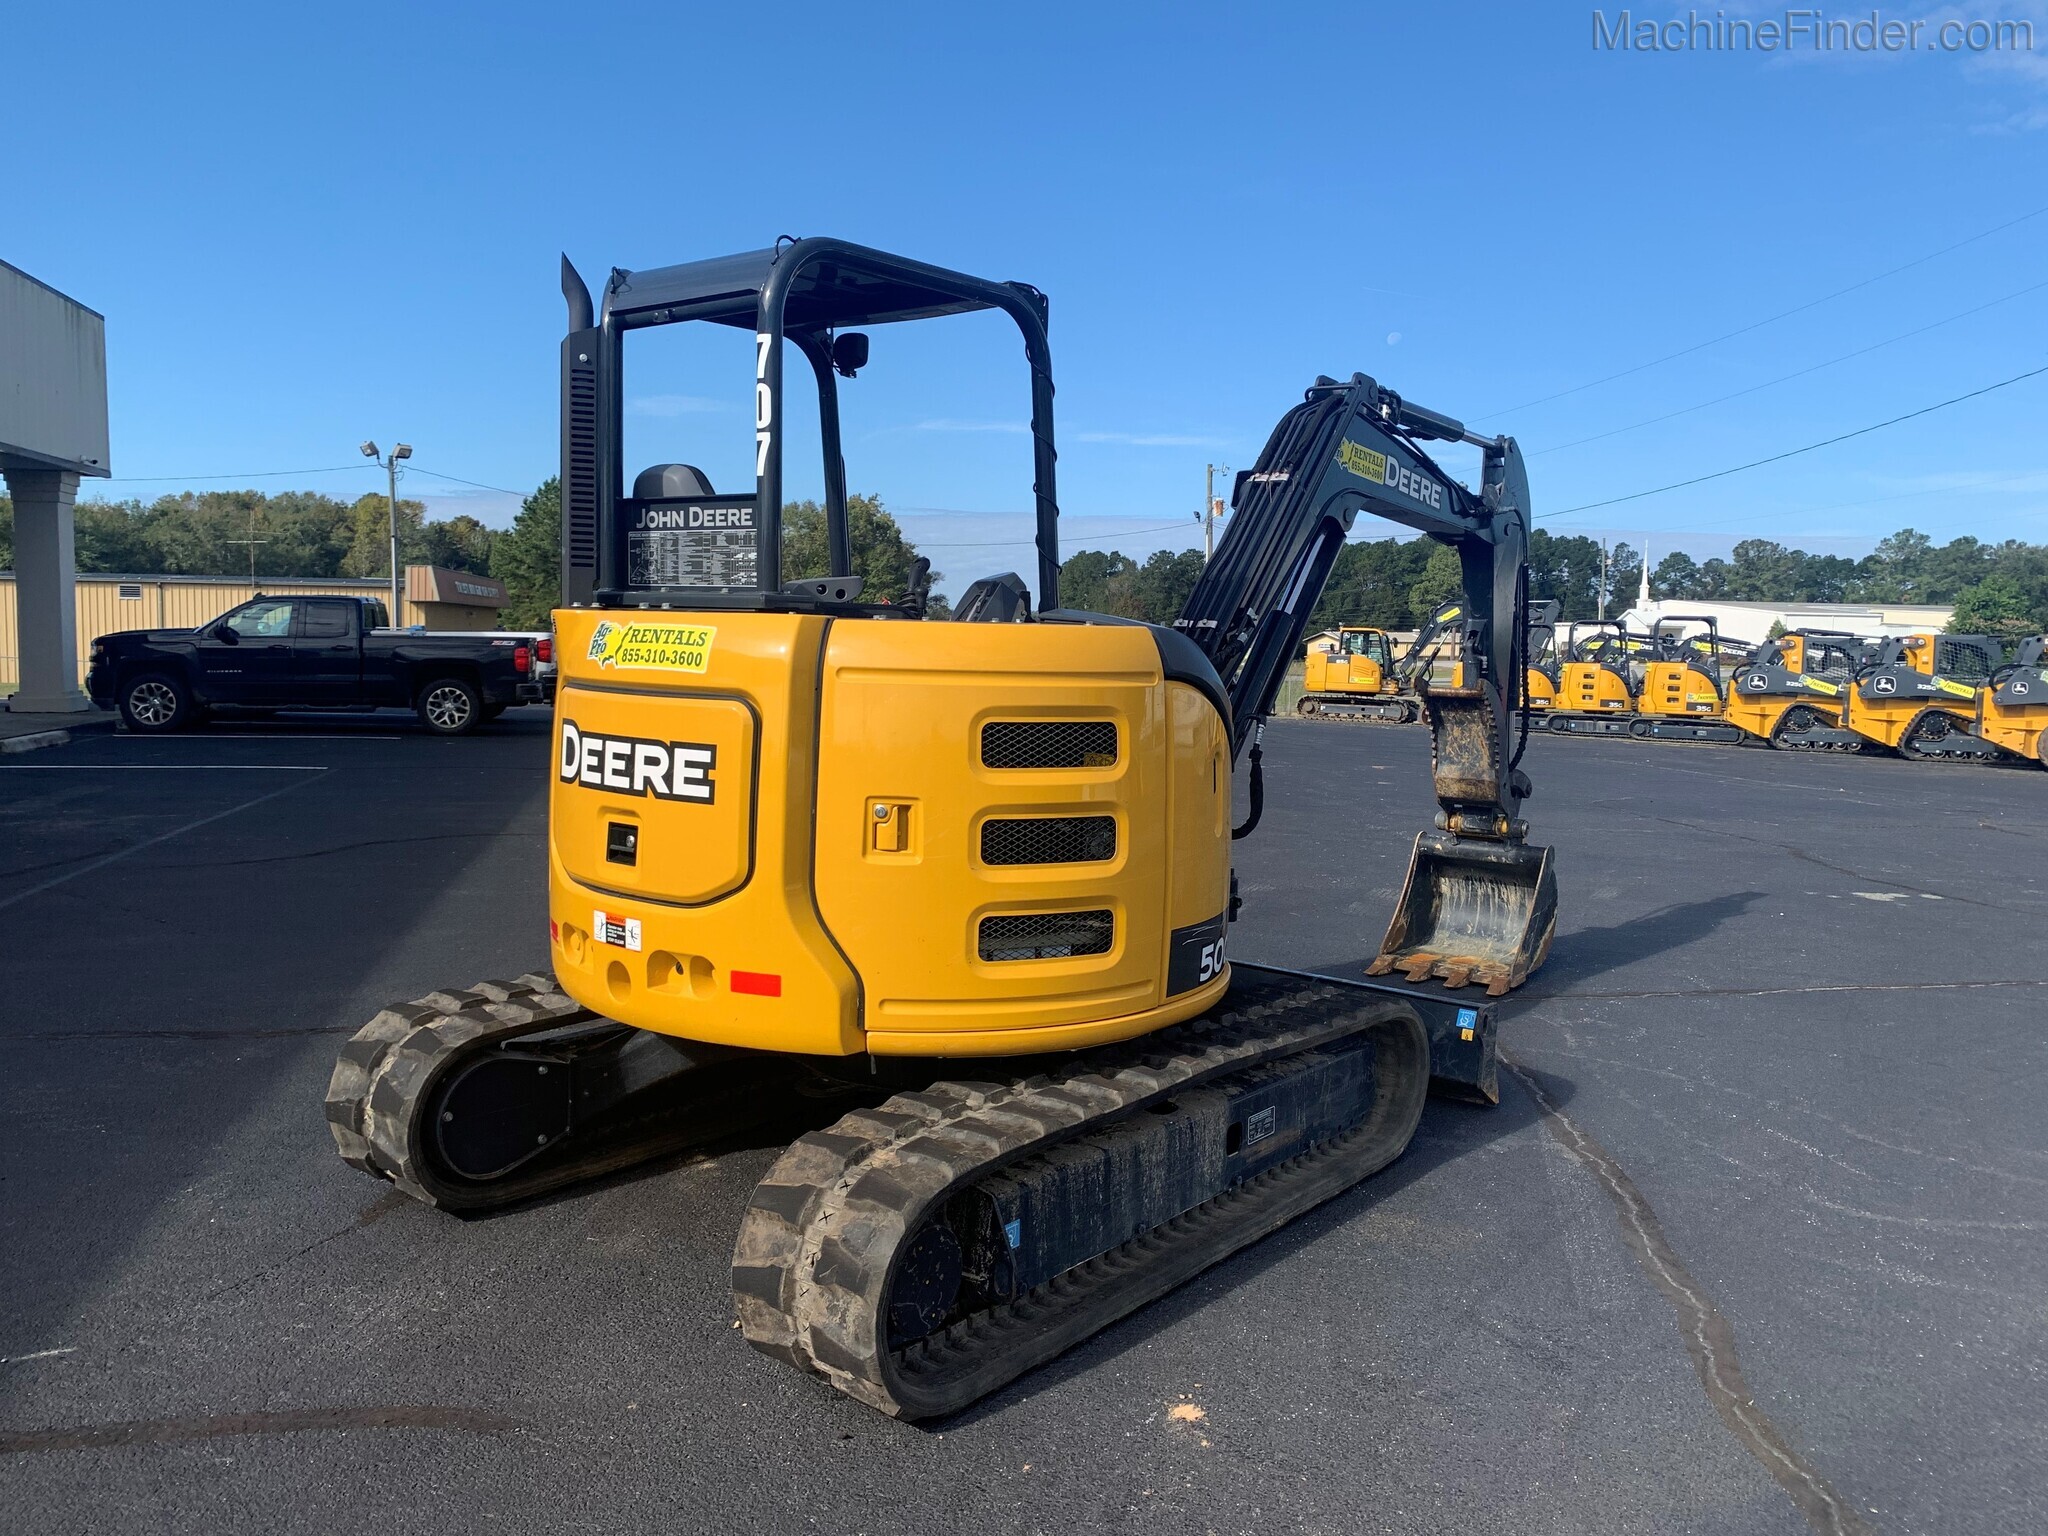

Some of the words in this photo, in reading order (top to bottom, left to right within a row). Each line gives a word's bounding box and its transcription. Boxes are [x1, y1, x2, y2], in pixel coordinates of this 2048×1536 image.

[756, 333, 772, 477] 707
[1353, 447, 1384, 468] RENTALS
[1385, 455, 1442, 510] DEERE
[636, 508, 685, 529] JOHN
[689, 506, 753, 528] DEERE
[628, 628, 708, 648] RENTALS
[621, 648, 703, 668] 855-310-3600
[1722, 646, 1748, 657] DEERE
[1695, 704, 1712, 712] 35G
[560, 719, 715, 802] DEERE
[1199, 937, 1225, 982] 50
